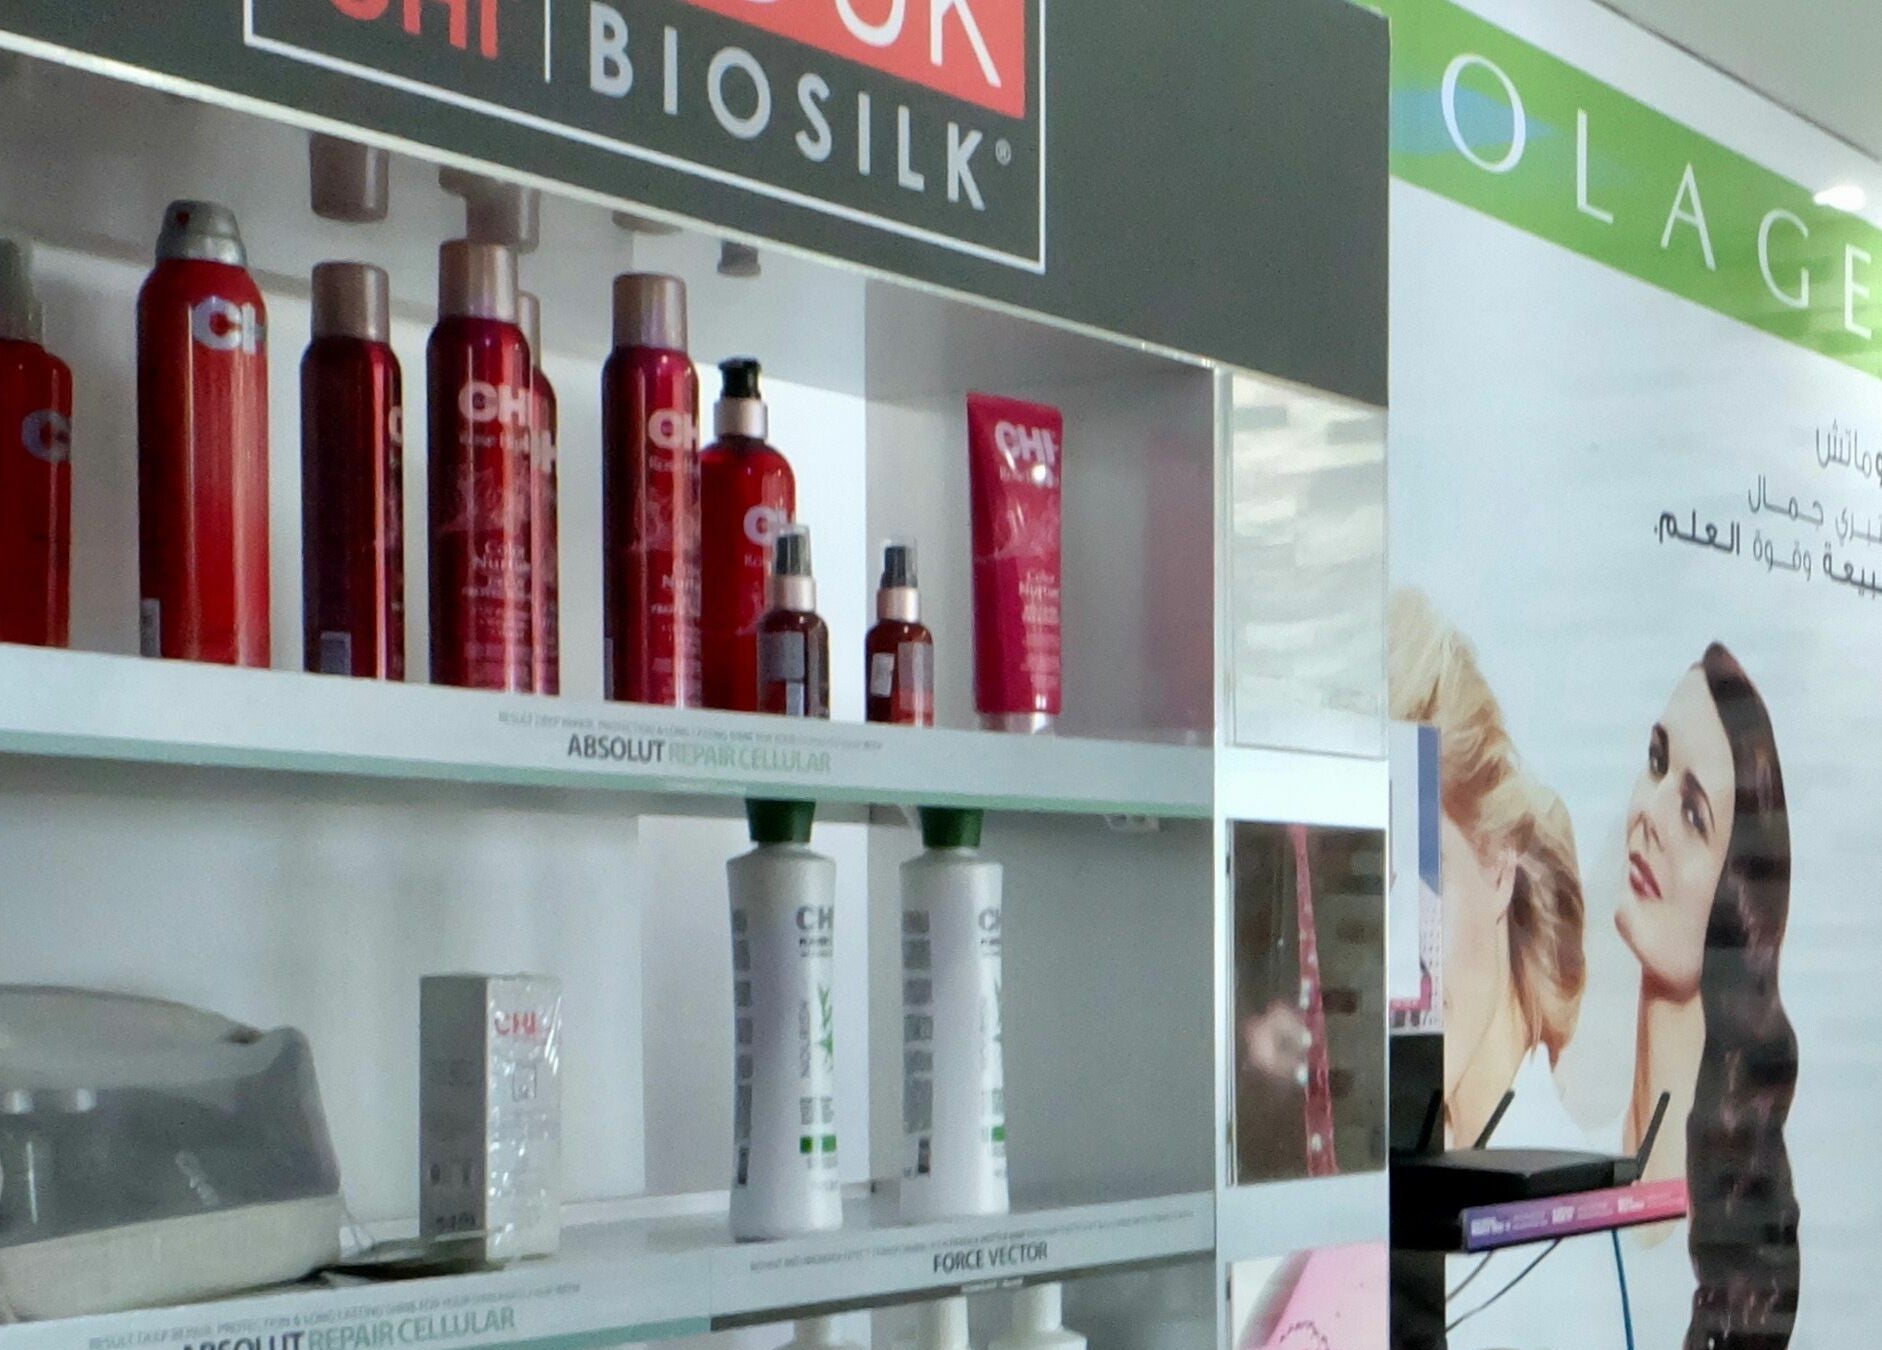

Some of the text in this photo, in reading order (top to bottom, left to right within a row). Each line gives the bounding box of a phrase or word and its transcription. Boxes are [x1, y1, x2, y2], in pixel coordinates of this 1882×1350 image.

[1748, 474, 1824, 532] جمال
[567, 732, 666, 764] ABSOLUT
[932, 1248, 987, 1274] FORCE
[987, 1241, 1049, 1266] VECTOR
[397, 1306, 516, 1345] CELLULAR
